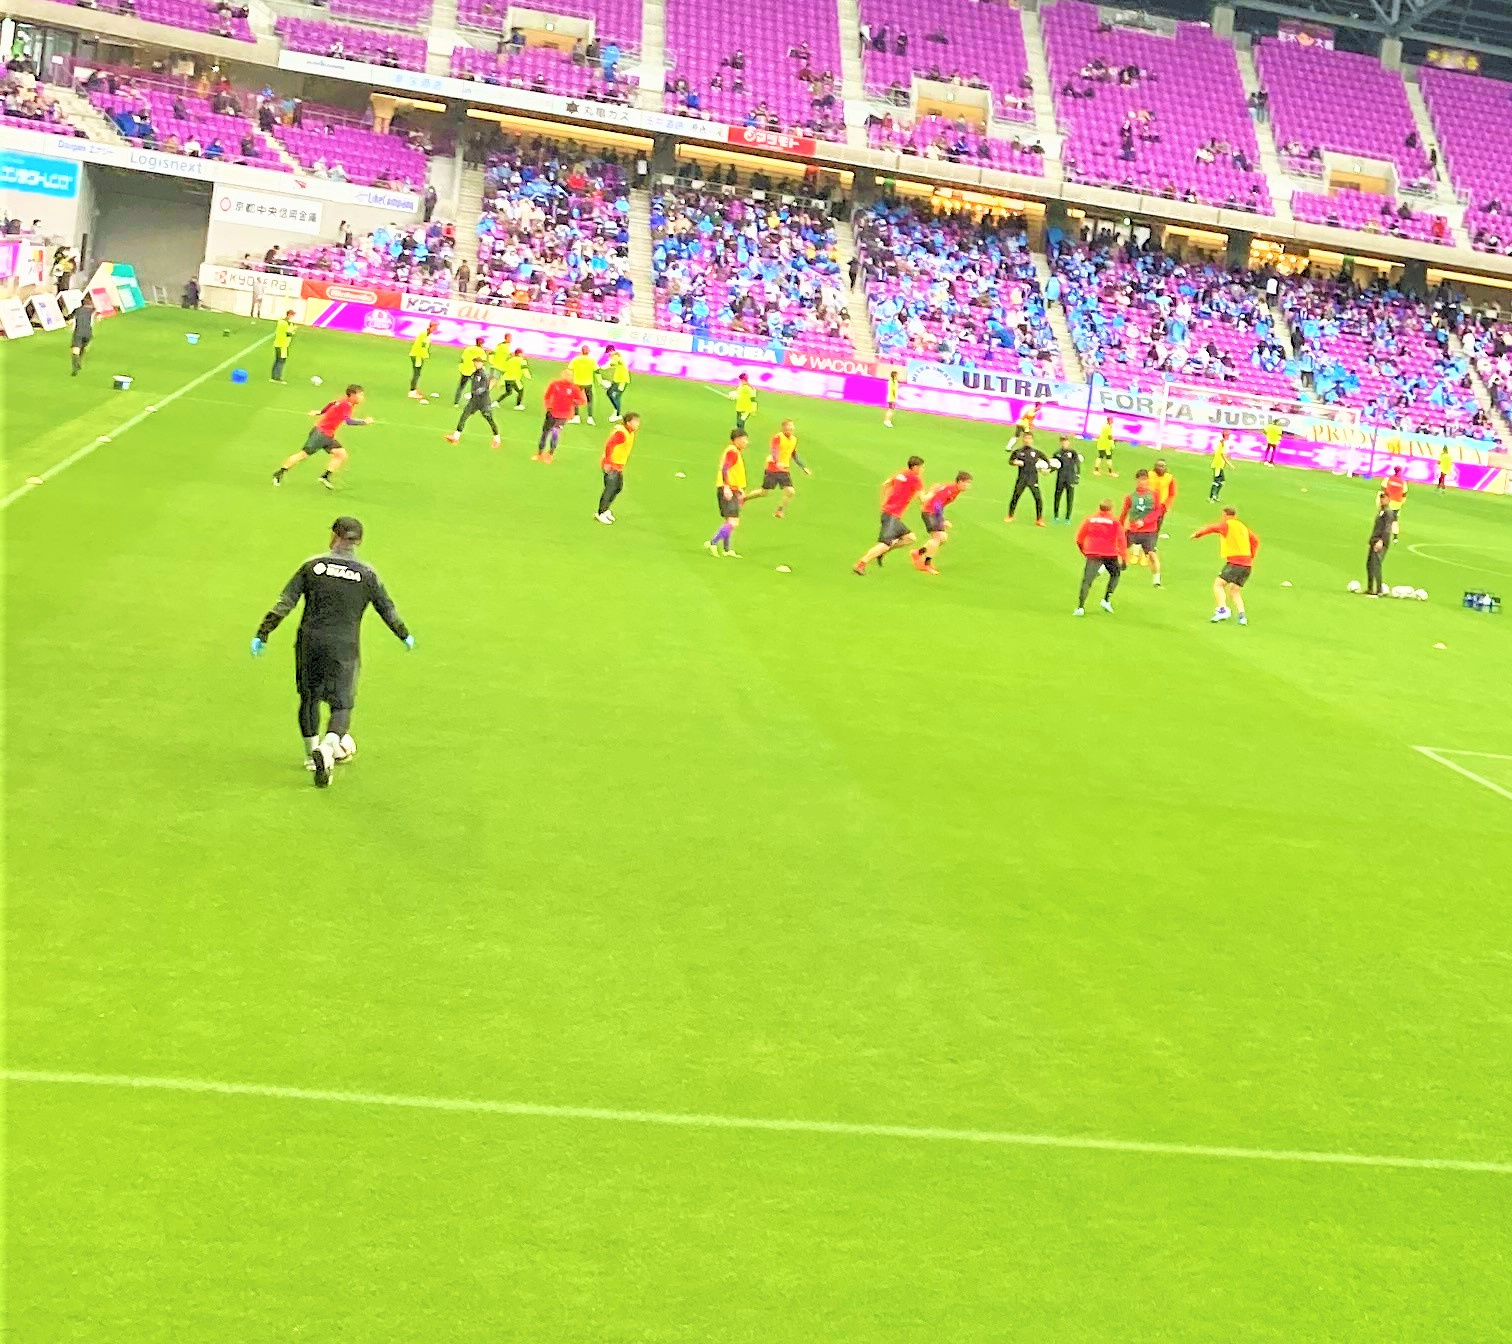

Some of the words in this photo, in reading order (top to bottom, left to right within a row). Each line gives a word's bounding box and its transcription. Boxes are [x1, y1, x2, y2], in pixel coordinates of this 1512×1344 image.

[131, 153, 202, 174] Logisnext
[458, 306, 490, 321] au
[700, 340, 777, 363] HORIBA
[810, 354, 872, 376] WACOAL
[962, 370, 1052, 398] ULTRA
[1100, 391, 1194, 421] FORZA
